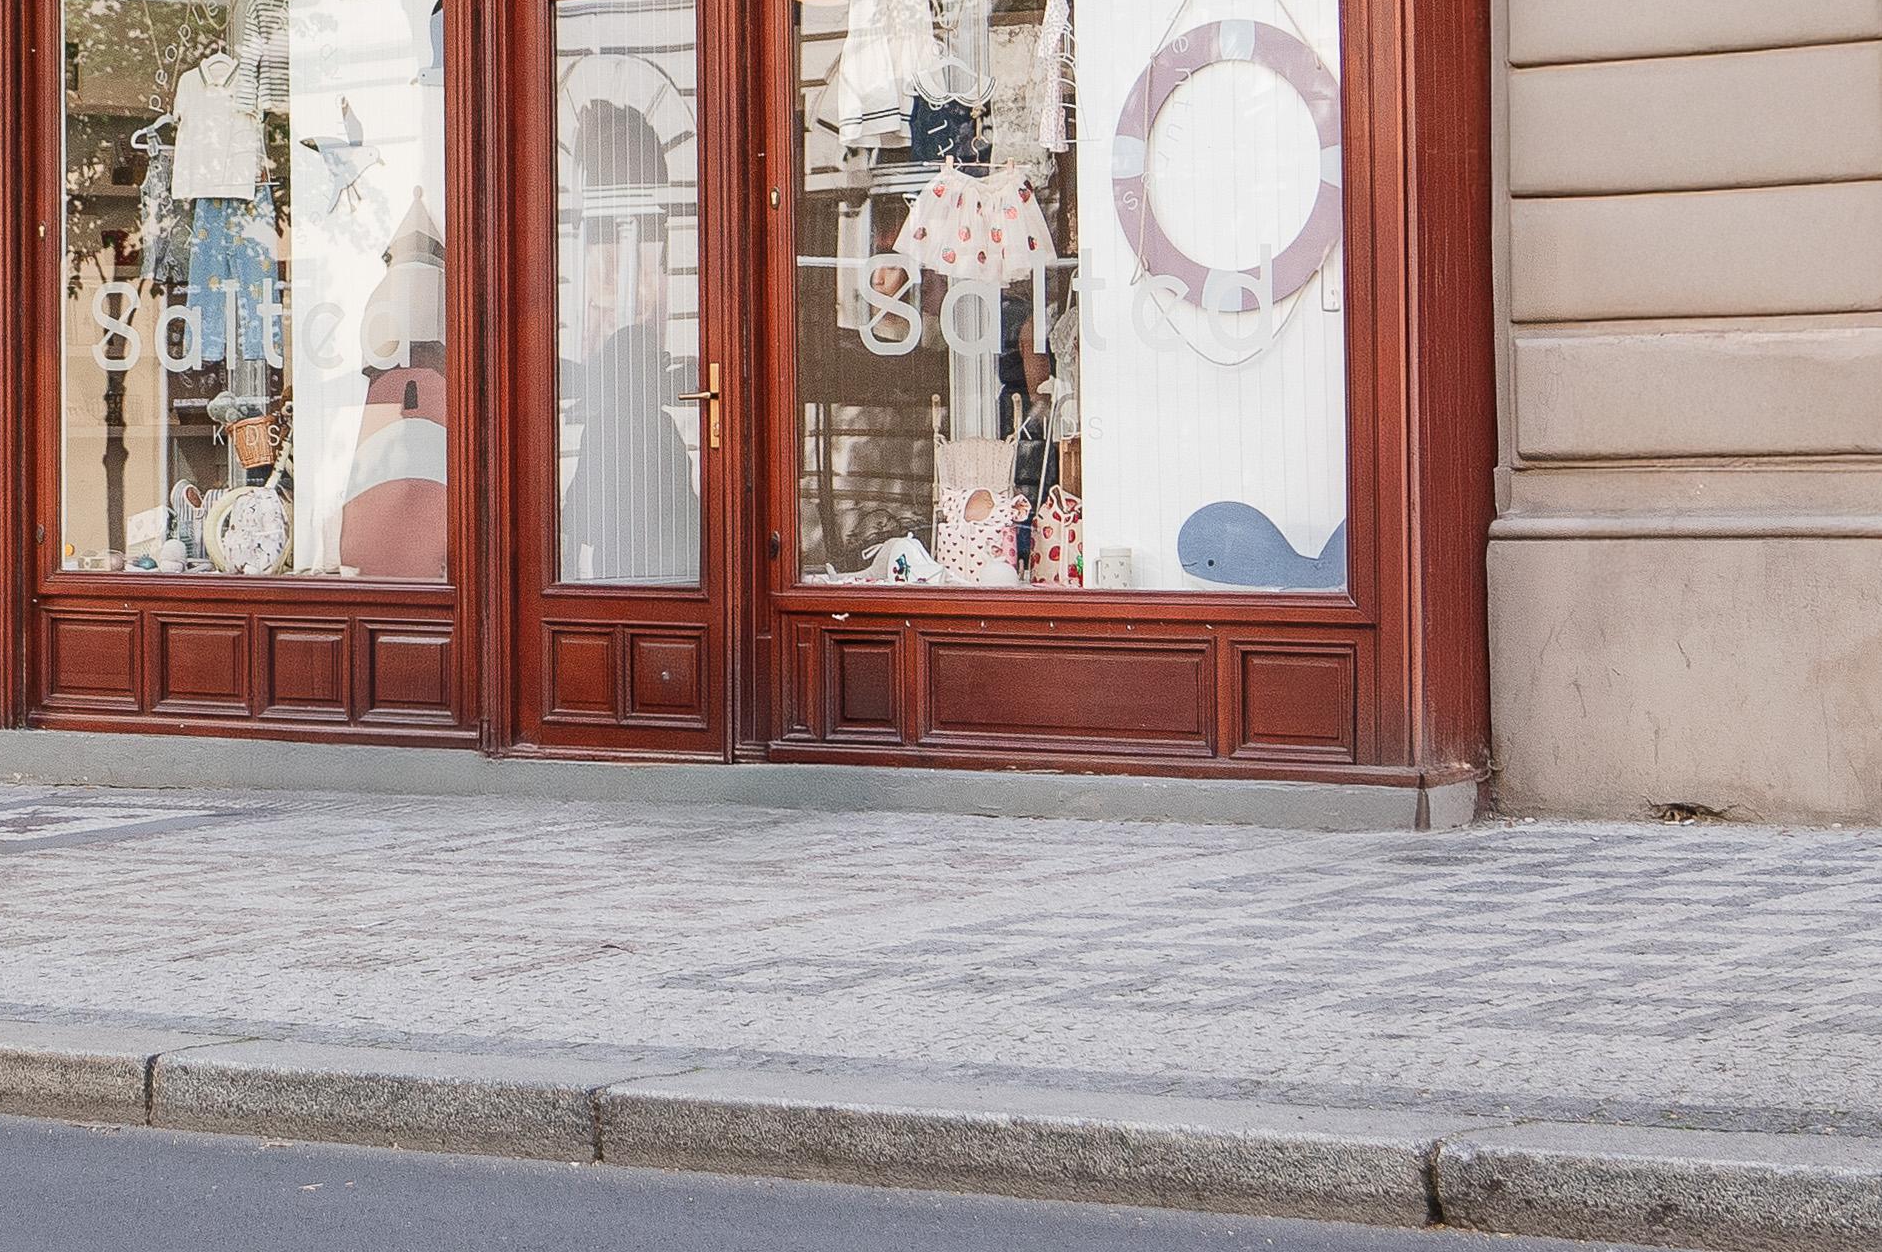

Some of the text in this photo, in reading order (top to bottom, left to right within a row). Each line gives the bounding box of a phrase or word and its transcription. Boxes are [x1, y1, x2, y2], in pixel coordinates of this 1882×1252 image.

[148, 0, 219, 113] people
[91, 277, 412, 374] Salted
[212, 424, 281, 447] KIDS
[1018, 415, 1104, 441] KIDS
